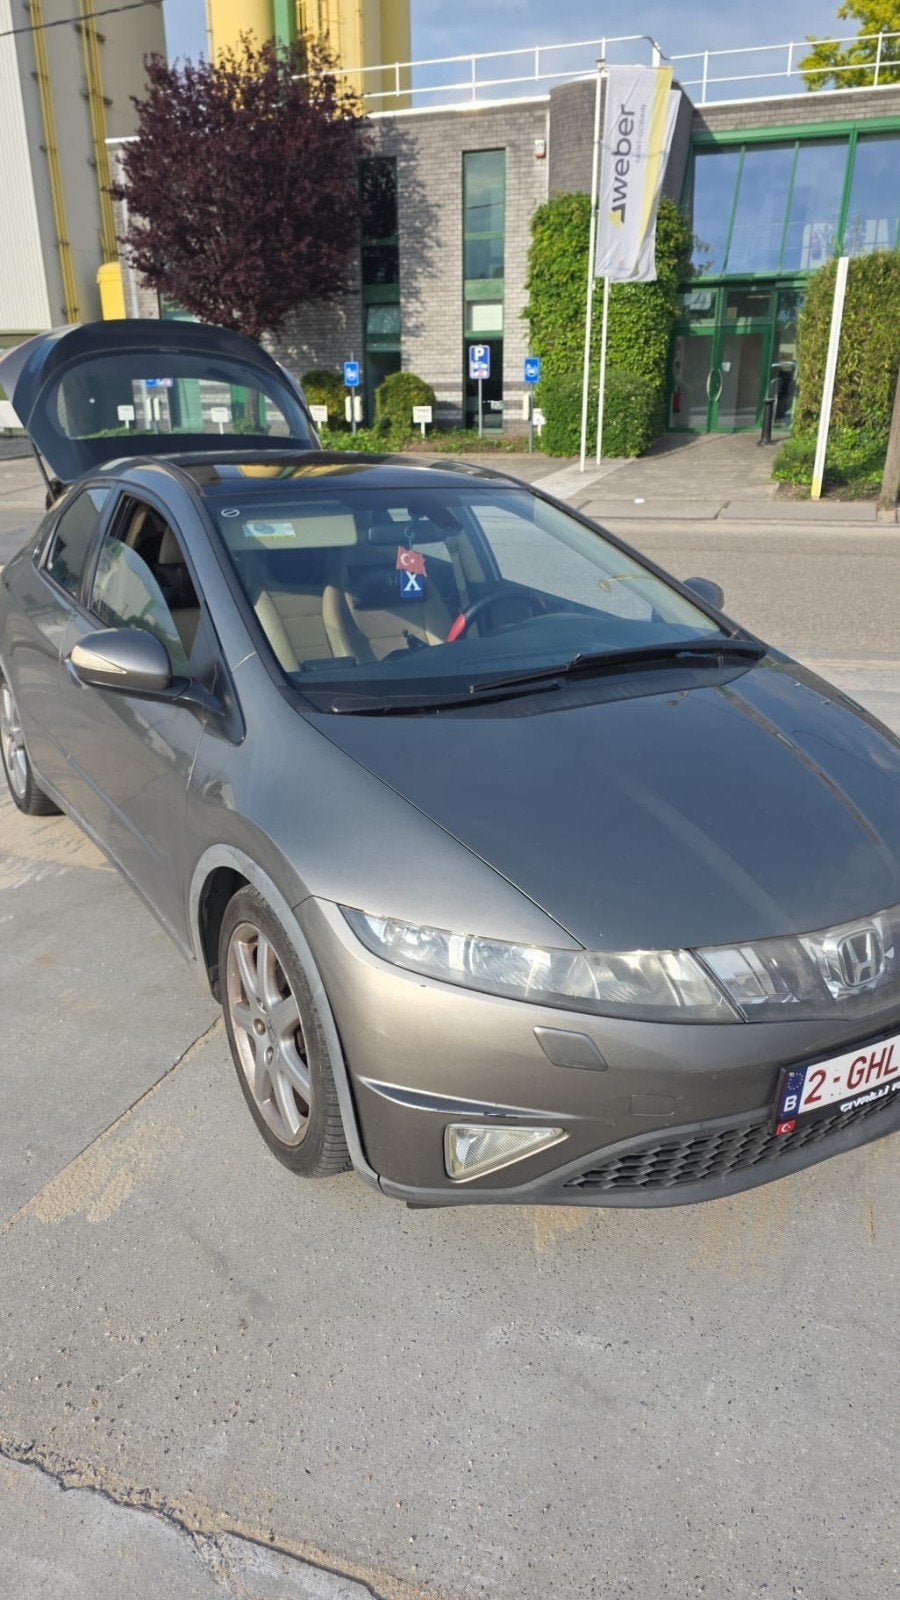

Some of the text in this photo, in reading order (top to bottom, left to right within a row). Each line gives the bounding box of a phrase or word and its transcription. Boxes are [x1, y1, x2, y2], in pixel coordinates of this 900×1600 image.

[611, 104, 635, 204] weber
[474, 347, 485, 361] P
[783, 1095, 798, 1112] B
